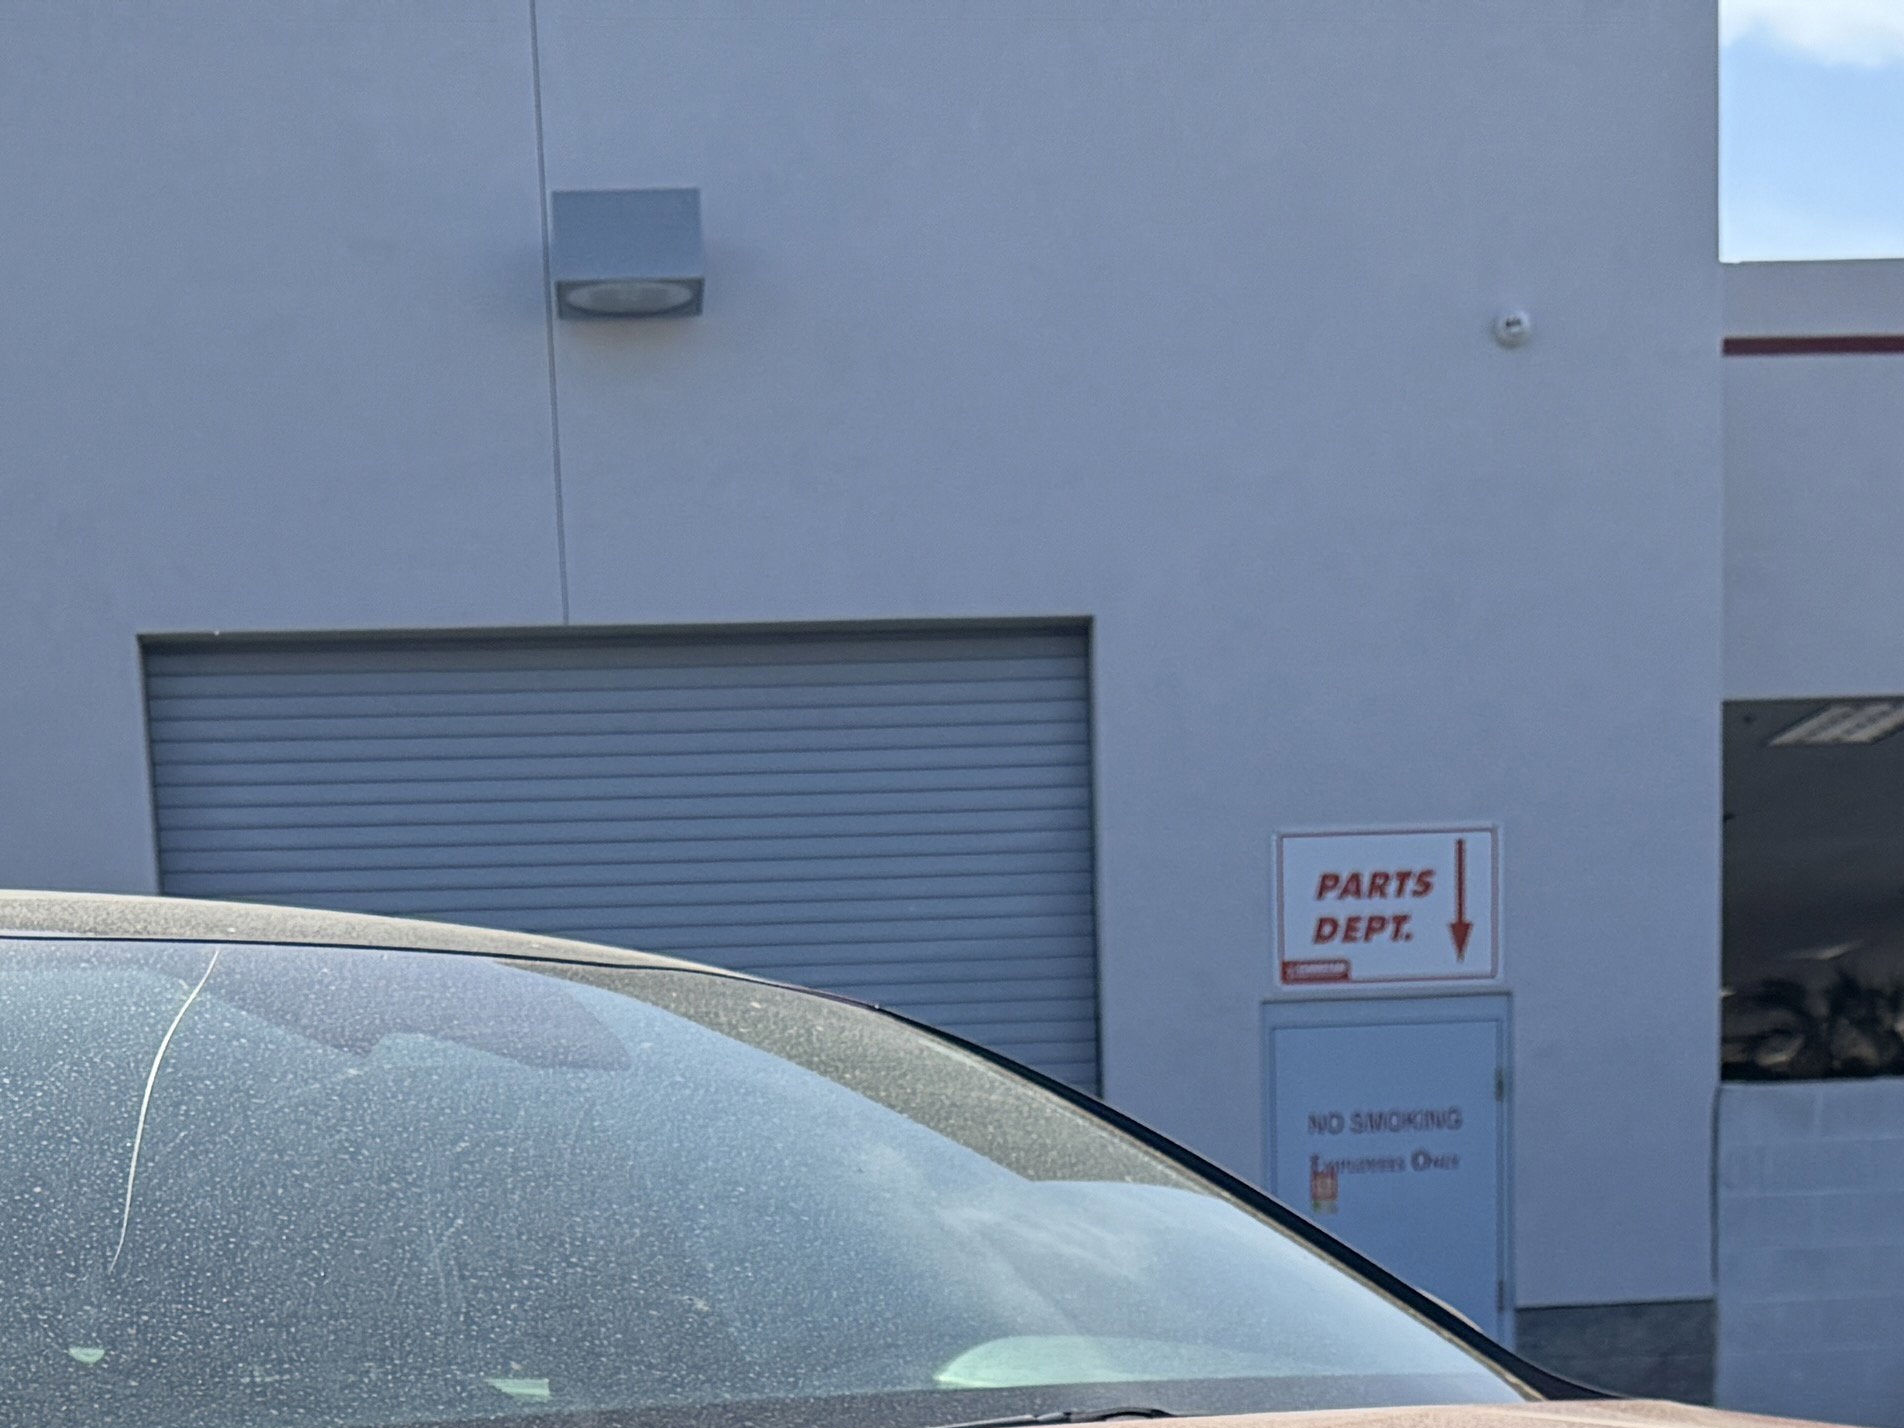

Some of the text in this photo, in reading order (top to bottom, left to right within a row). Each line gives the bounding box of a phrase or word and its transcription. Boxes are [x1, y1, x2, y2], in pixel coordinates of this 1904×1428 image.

[1315, 868, 1436, 900] PARTS
[1312, 913, 1413, 944] DEPT.
[1307, 1106, 1464, 1135] NO SMOKING
